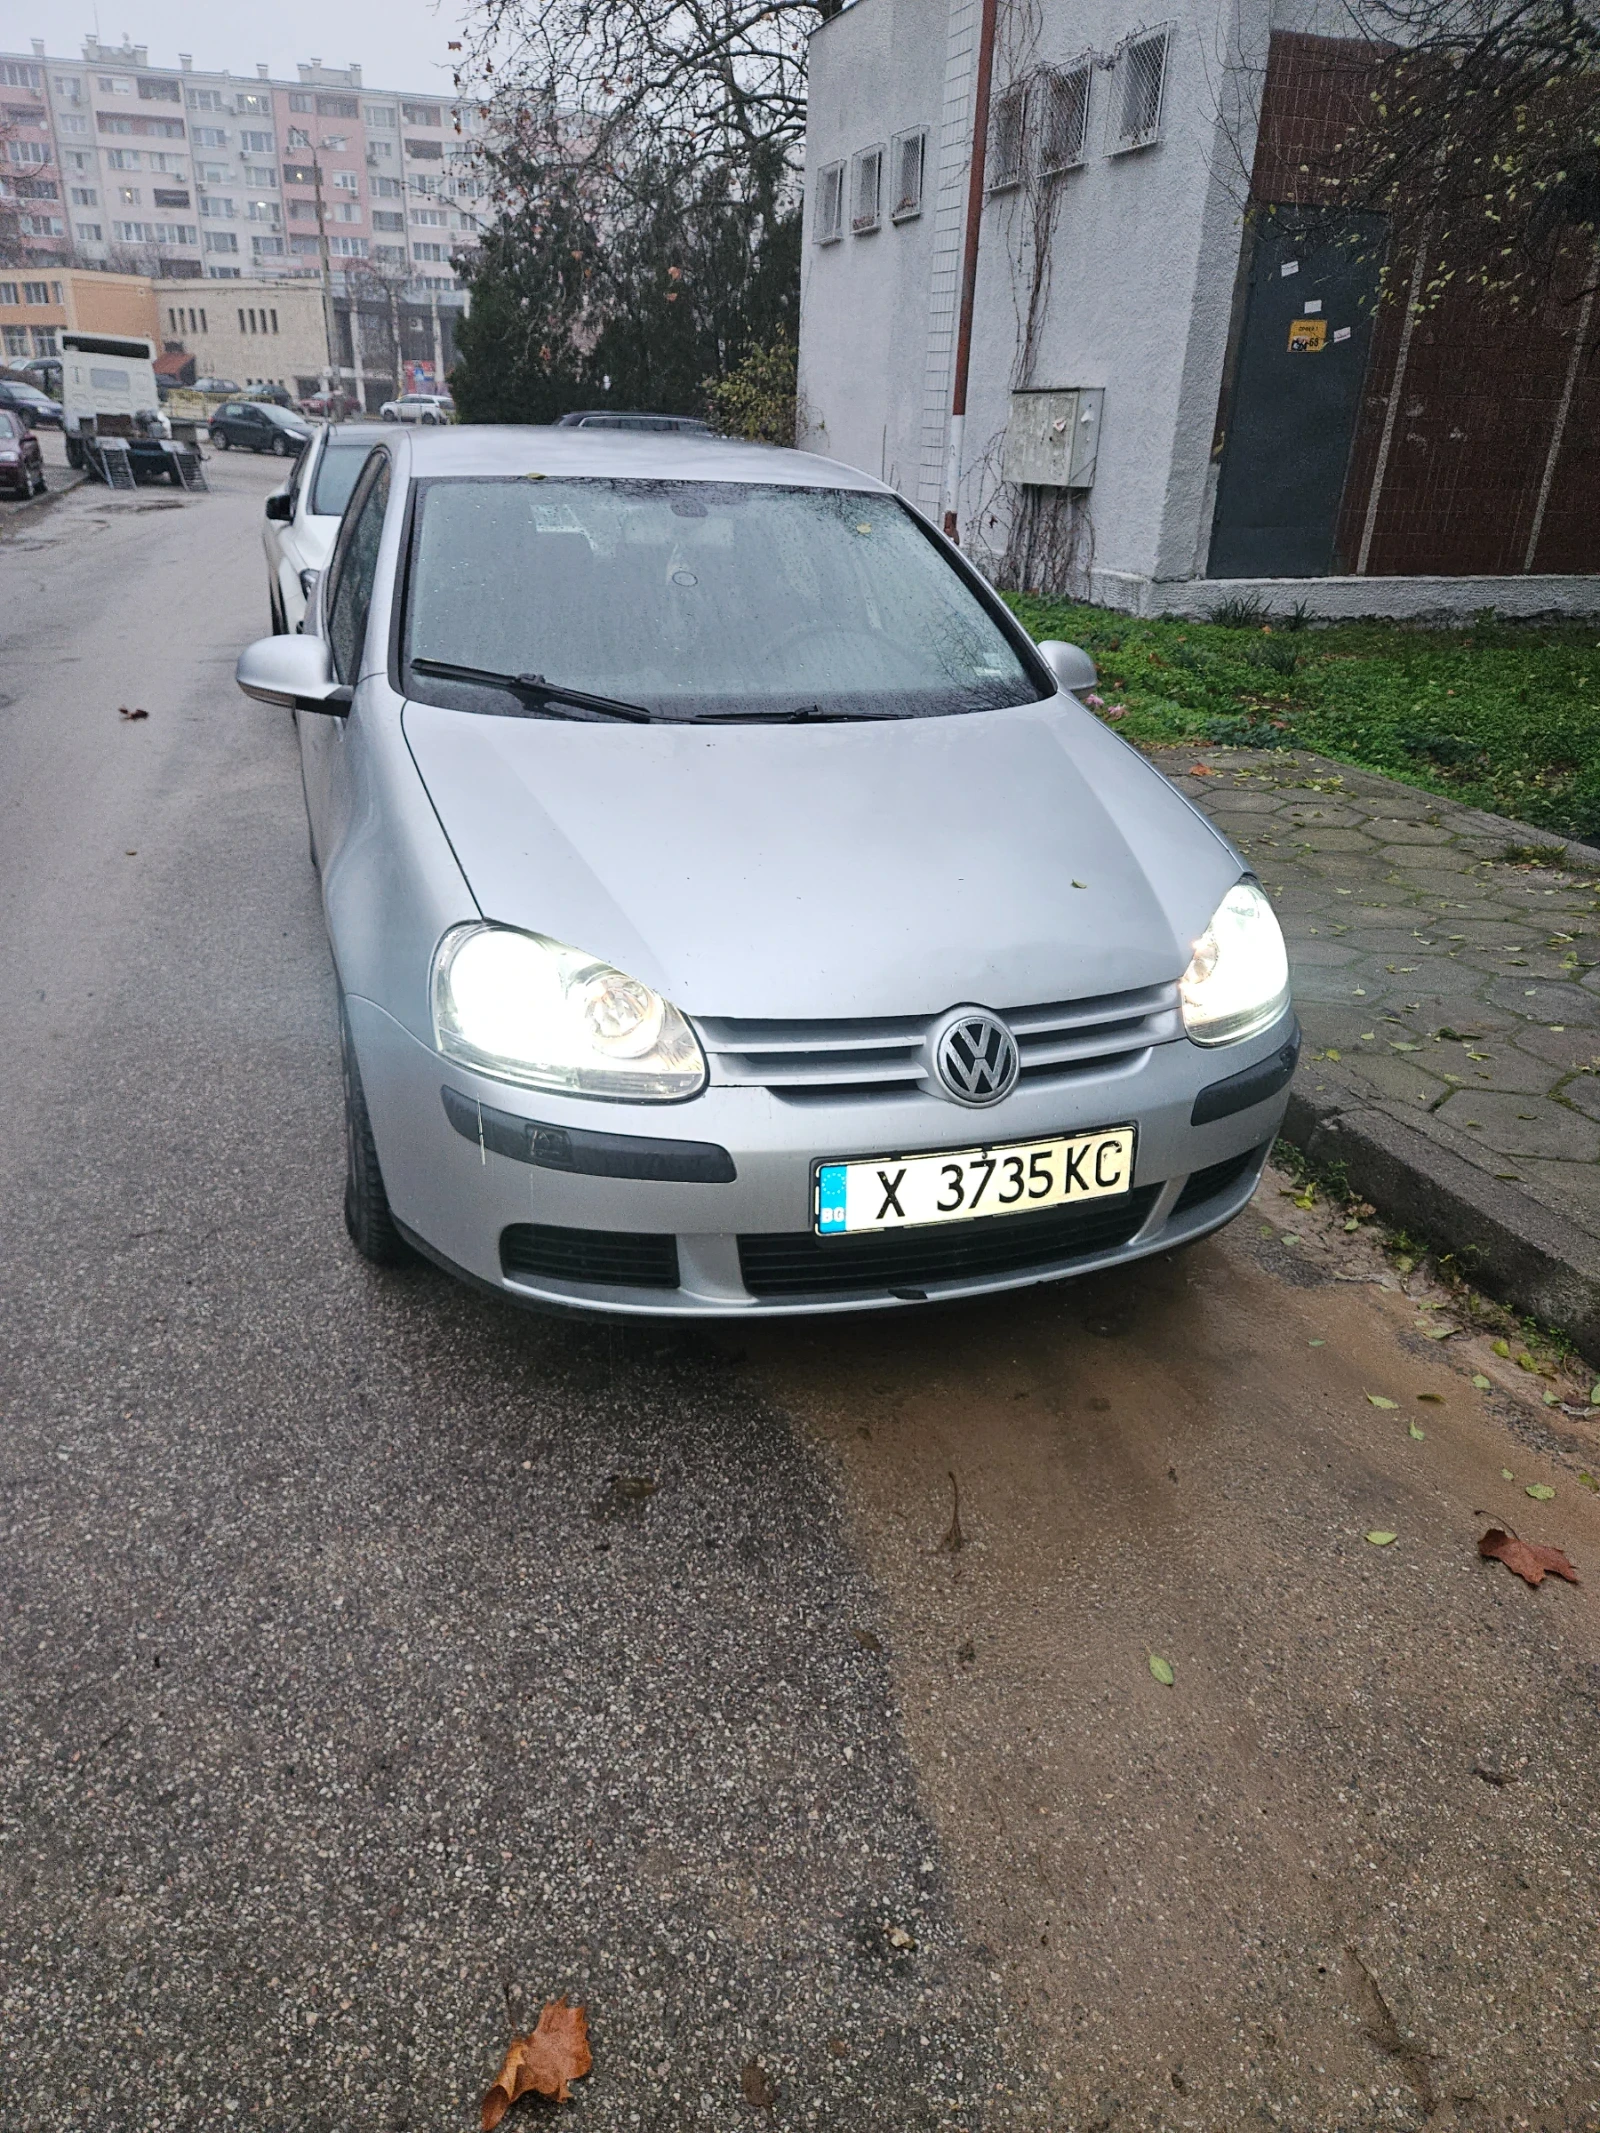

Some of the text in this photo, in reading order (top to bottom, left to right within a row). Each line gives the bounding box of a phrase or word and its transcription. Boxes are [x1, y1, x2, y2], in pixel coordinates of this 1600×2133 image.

[942, 1019, 1016, 1098] VW
[936, 1146, 1054, 1212] 3735
[821, 1206, 845, 1224] BG
